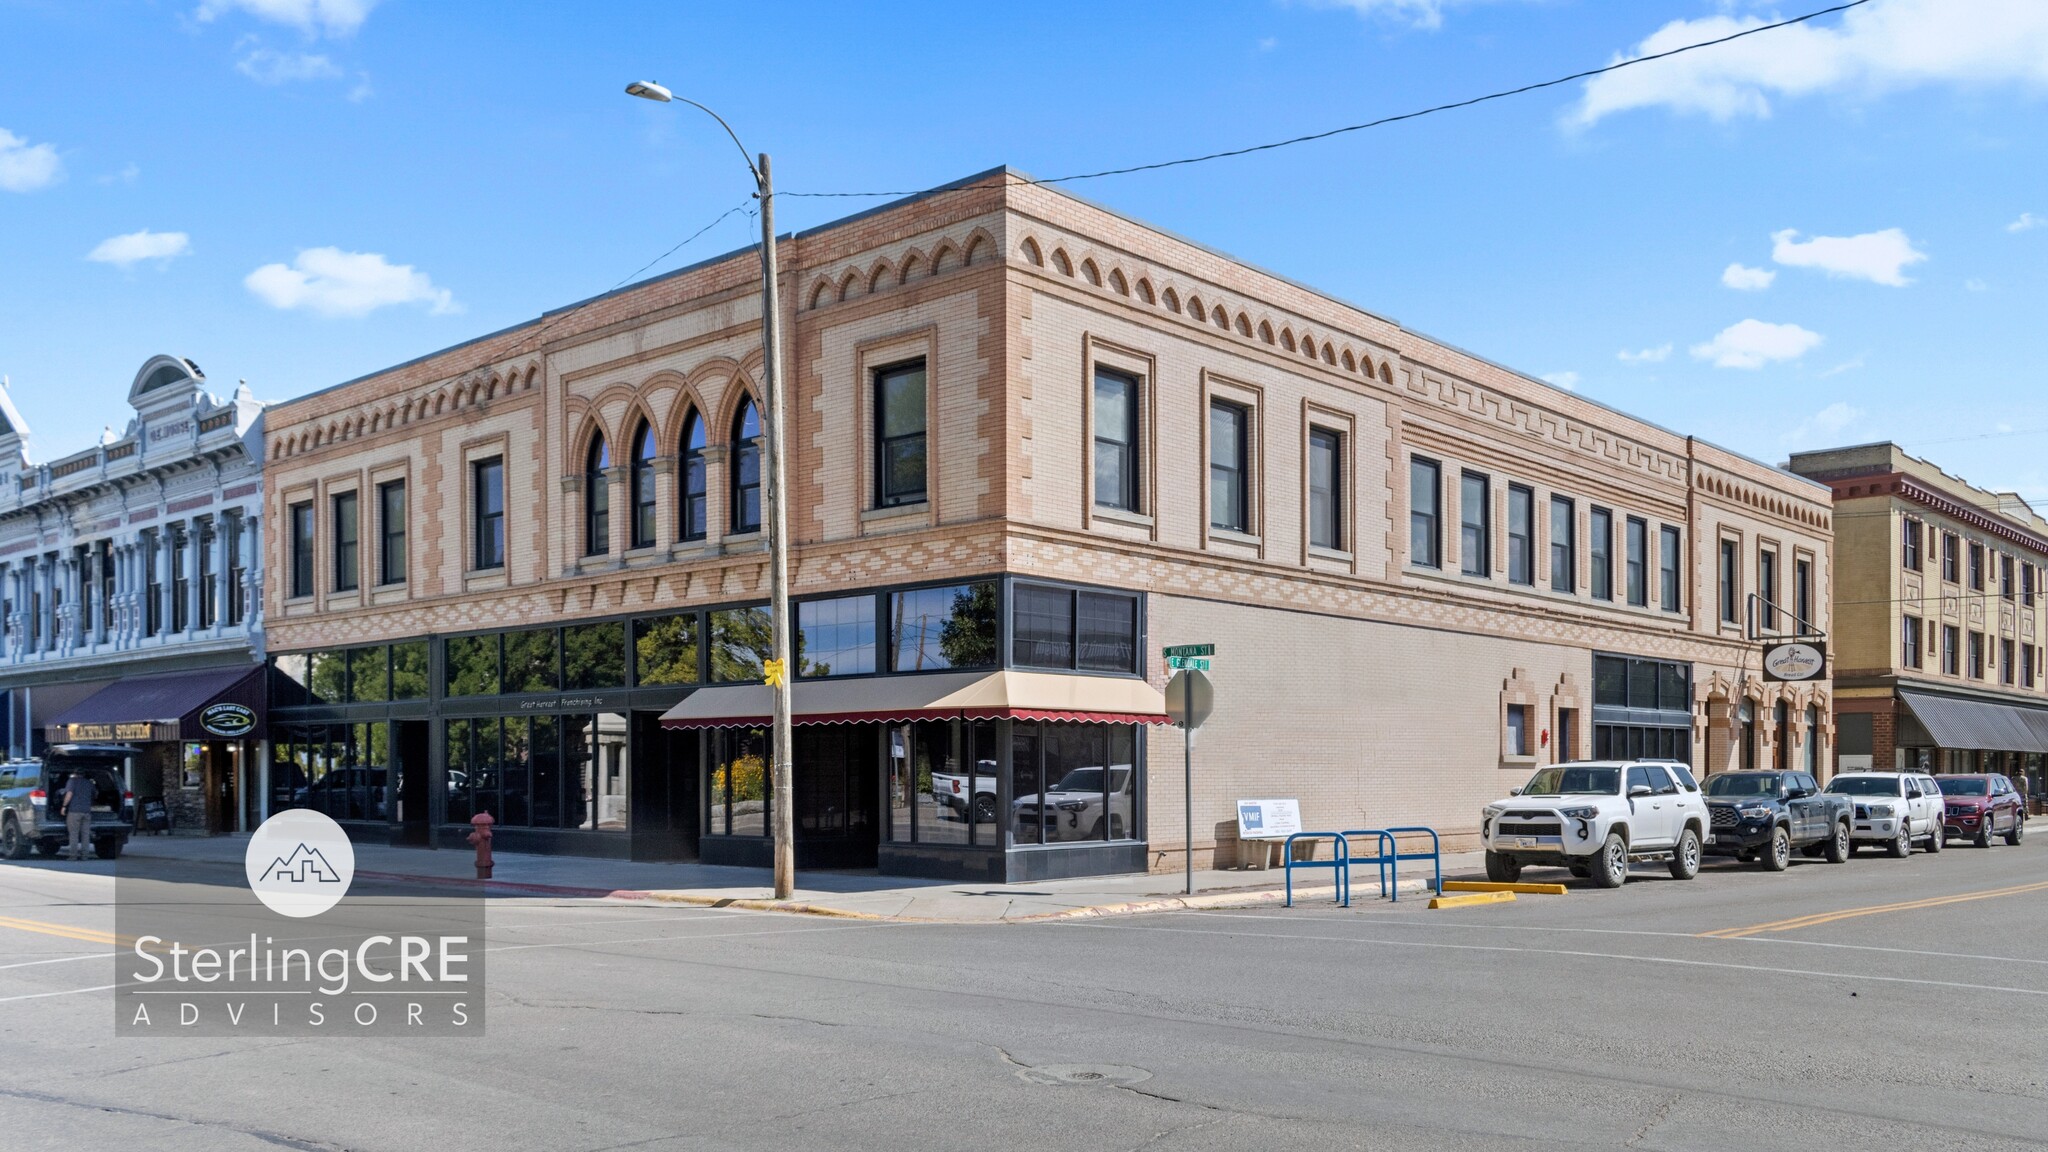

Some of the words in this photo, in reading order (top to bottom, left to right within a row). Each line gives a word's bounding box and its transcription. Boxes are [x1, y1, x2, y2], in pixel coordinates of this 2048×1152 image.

[1163, 649, 1168, 657] S
[1171, 646, 1198, 656] MONTANA
[1773, 656, 1790, 667] Great
[1794, 655, 1815, 666] Harvest
[521, 700, 536, 709] Great
[115, 723, 151, 739] STATION
